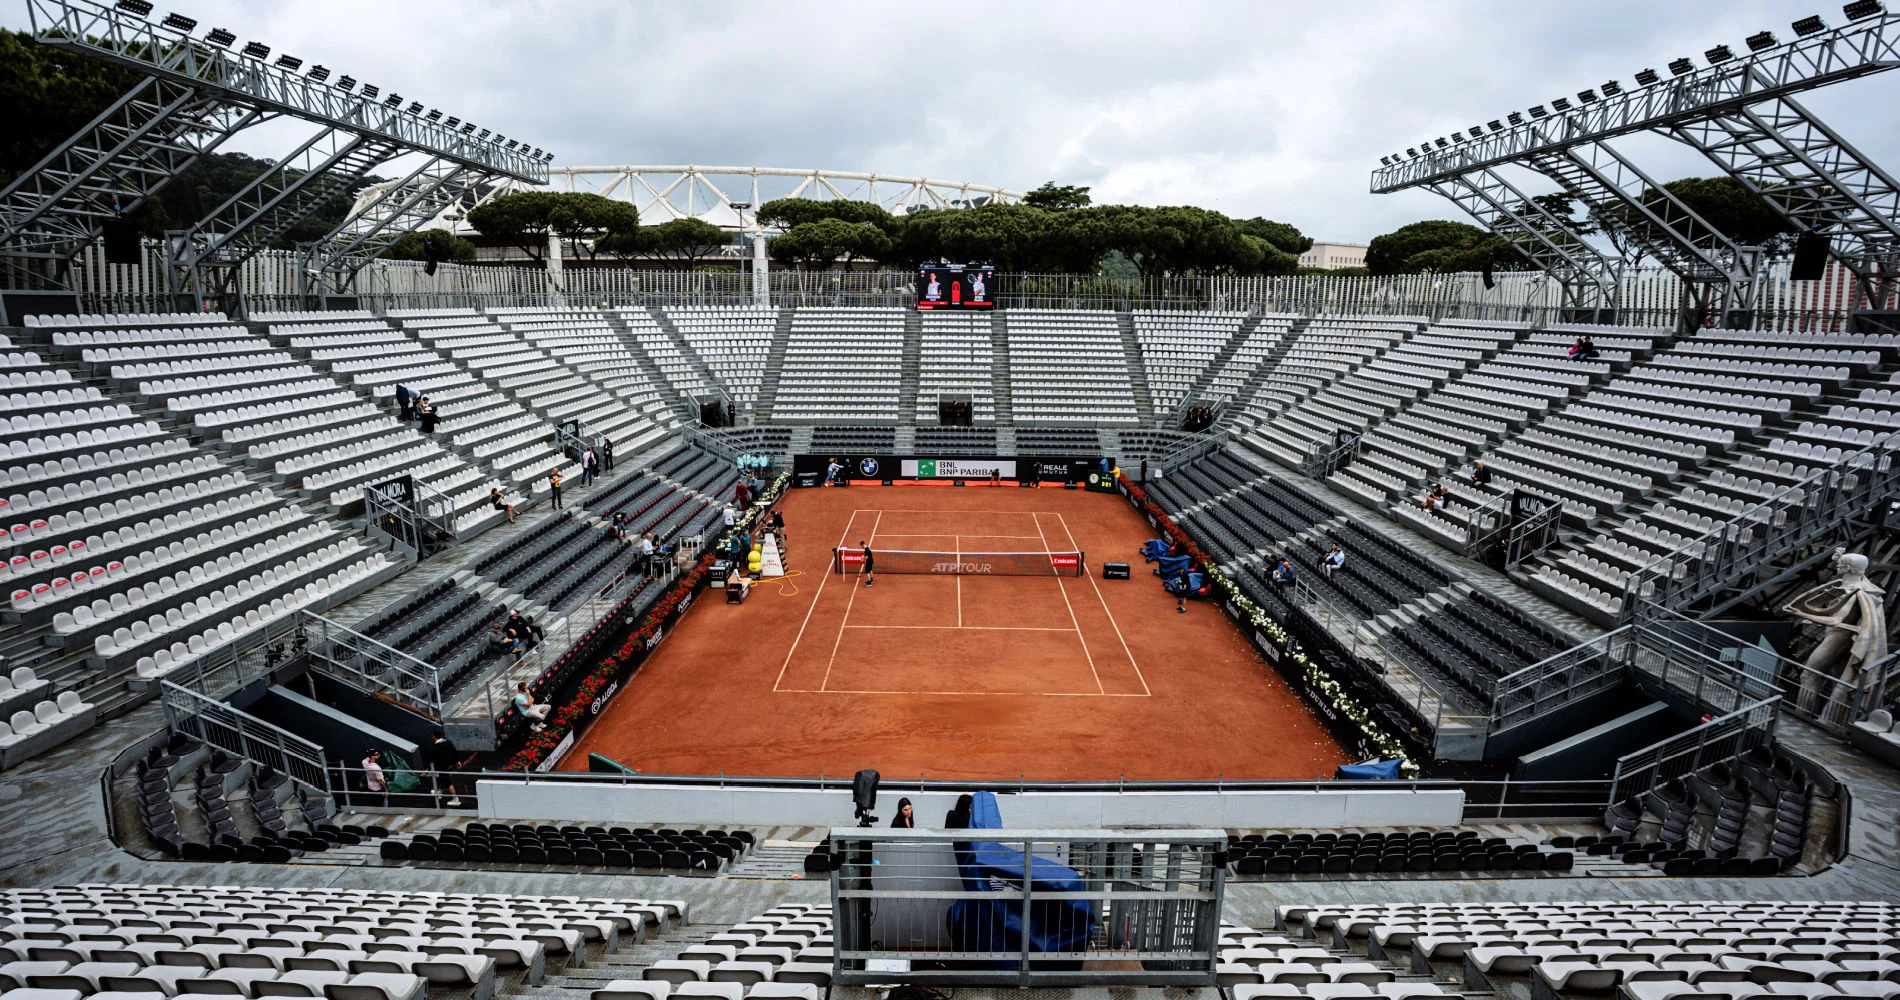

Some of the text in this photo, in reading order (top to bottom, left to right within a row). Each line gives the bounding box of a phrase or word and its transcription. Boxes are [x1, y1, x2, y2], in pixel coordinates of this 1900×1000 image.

[931, 563, 957, 572] ATP
[601, 679, 618, 705] ALGIDA
[1309, 691, 1337, 720] DUNLOP
